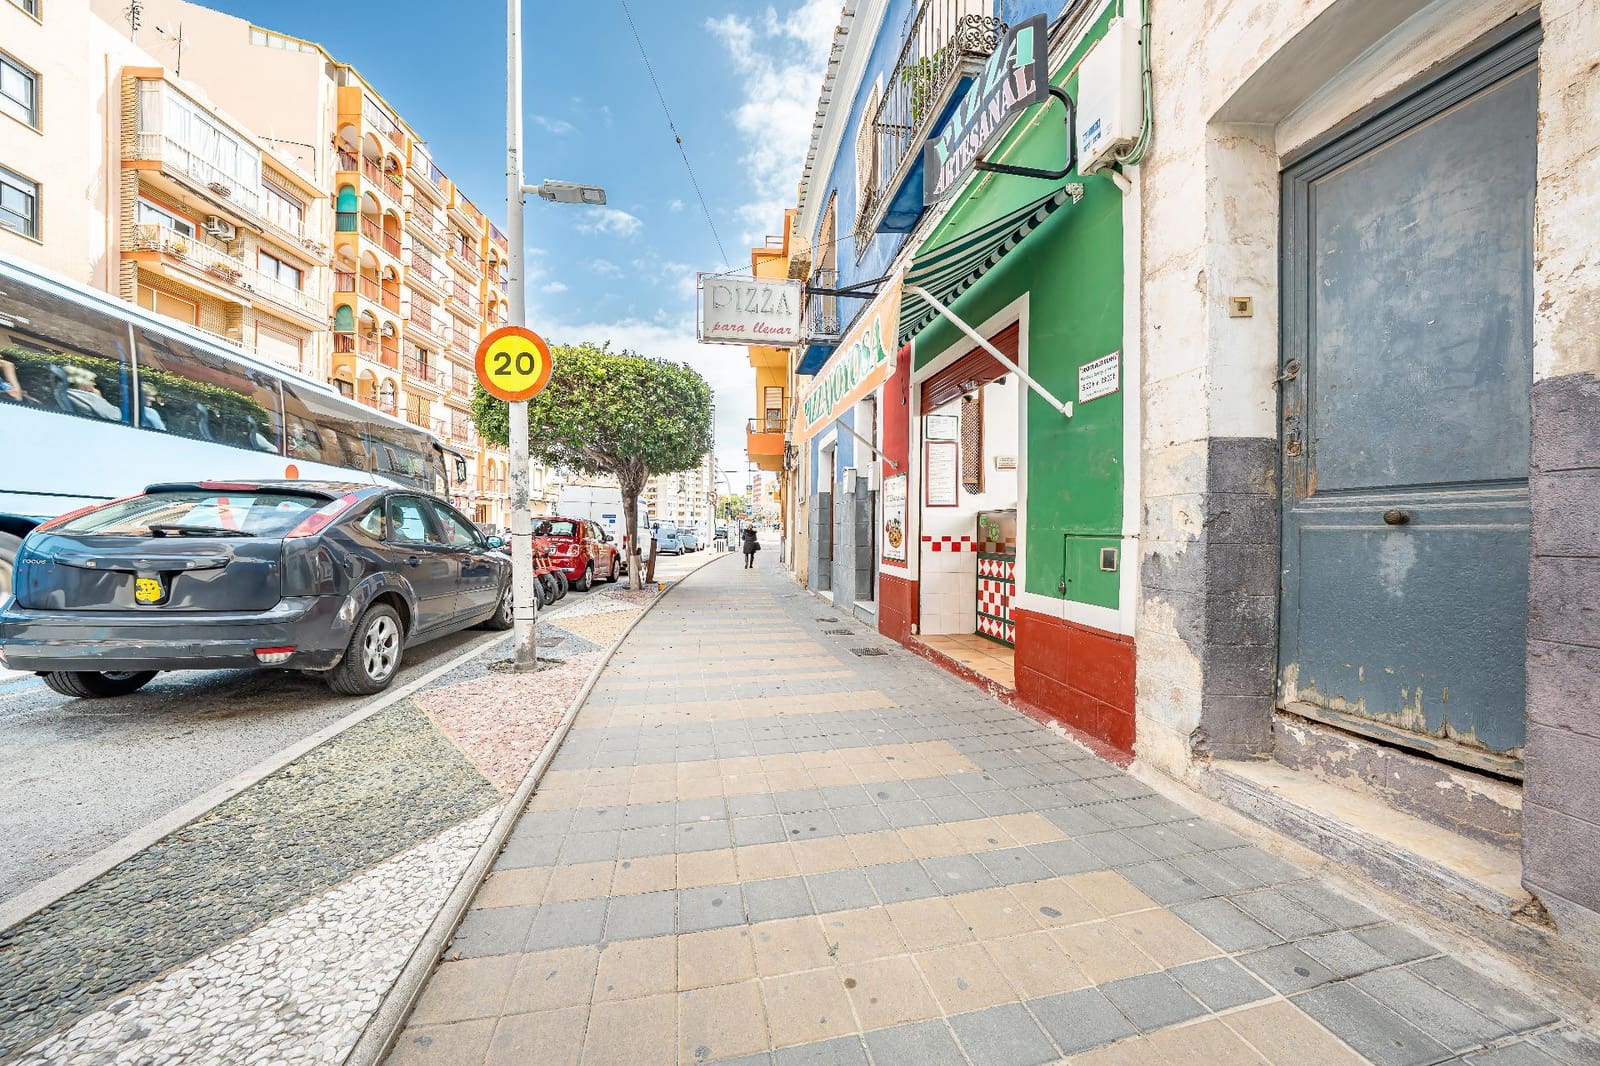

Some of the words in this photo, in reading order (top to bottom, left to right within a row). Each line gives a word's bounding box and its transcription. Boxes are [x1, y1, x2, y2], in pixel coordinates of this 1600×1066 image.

[934, 26, 1036, 165] PIZZA
[933, 66, 1037, 194] ARTESANAL
[713, 284, 792, 314] PIZZA
[711, 321, 745, 333] para
[752, 322, 792, 335] llevar
[493, 351, 535, 376] 20
